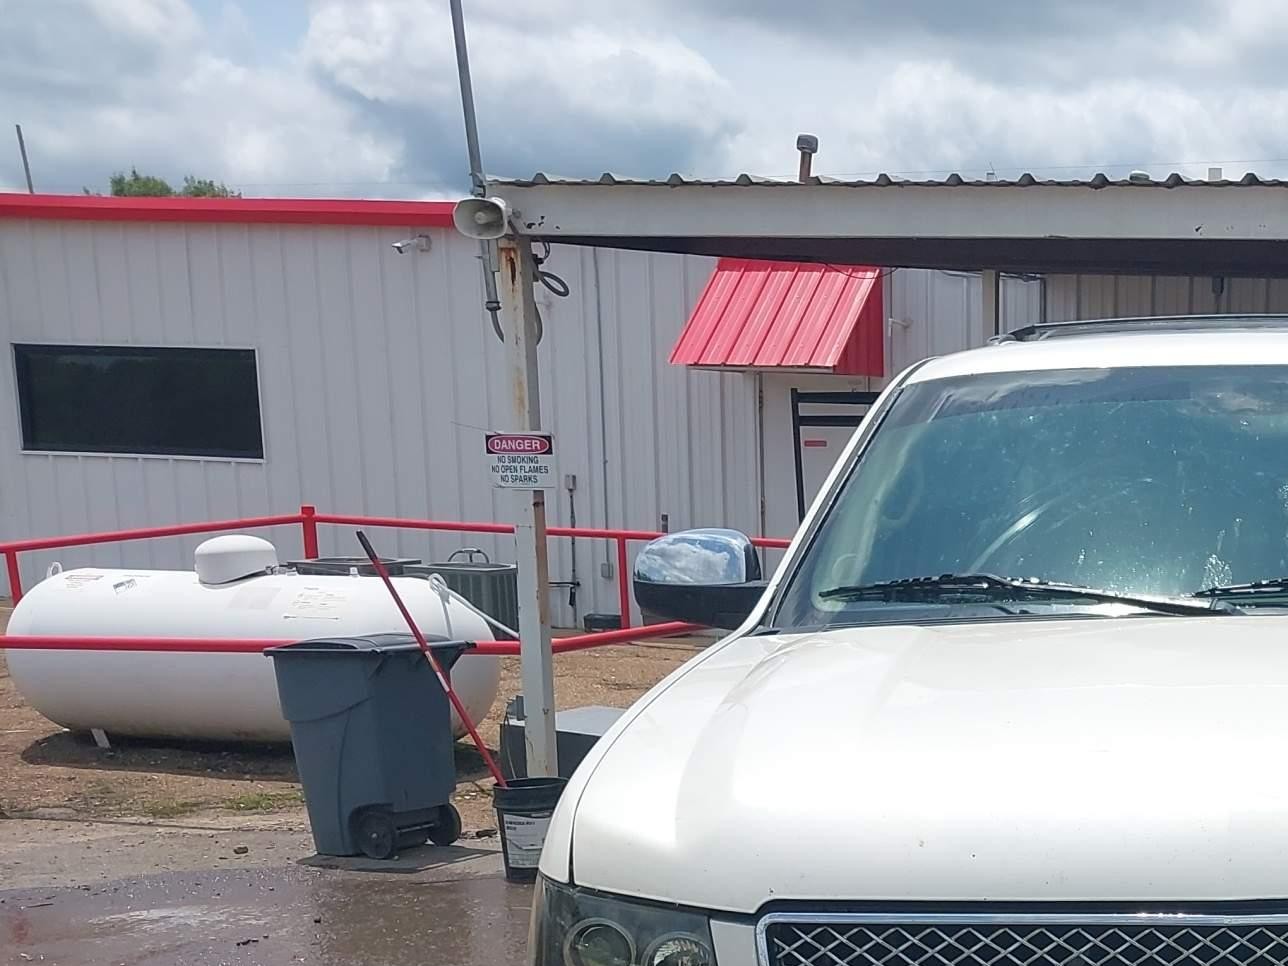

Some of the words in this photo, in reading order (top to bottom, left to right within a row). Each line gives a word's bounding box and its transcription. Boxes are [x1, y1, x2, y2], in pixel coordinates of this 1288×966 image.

[494, 439, 541, 450] DANGER
[497, 456, 507, 464] NO
[508, 456, 539, 464] SMOKING
[491, 465, 500, 473] NO
[501, 465, 518, 474] OPEN
[520, 466, 549, 474] FLAMES
[501, 475, 510, 483] NO
[510, 475, 539, 483] SPARKS
